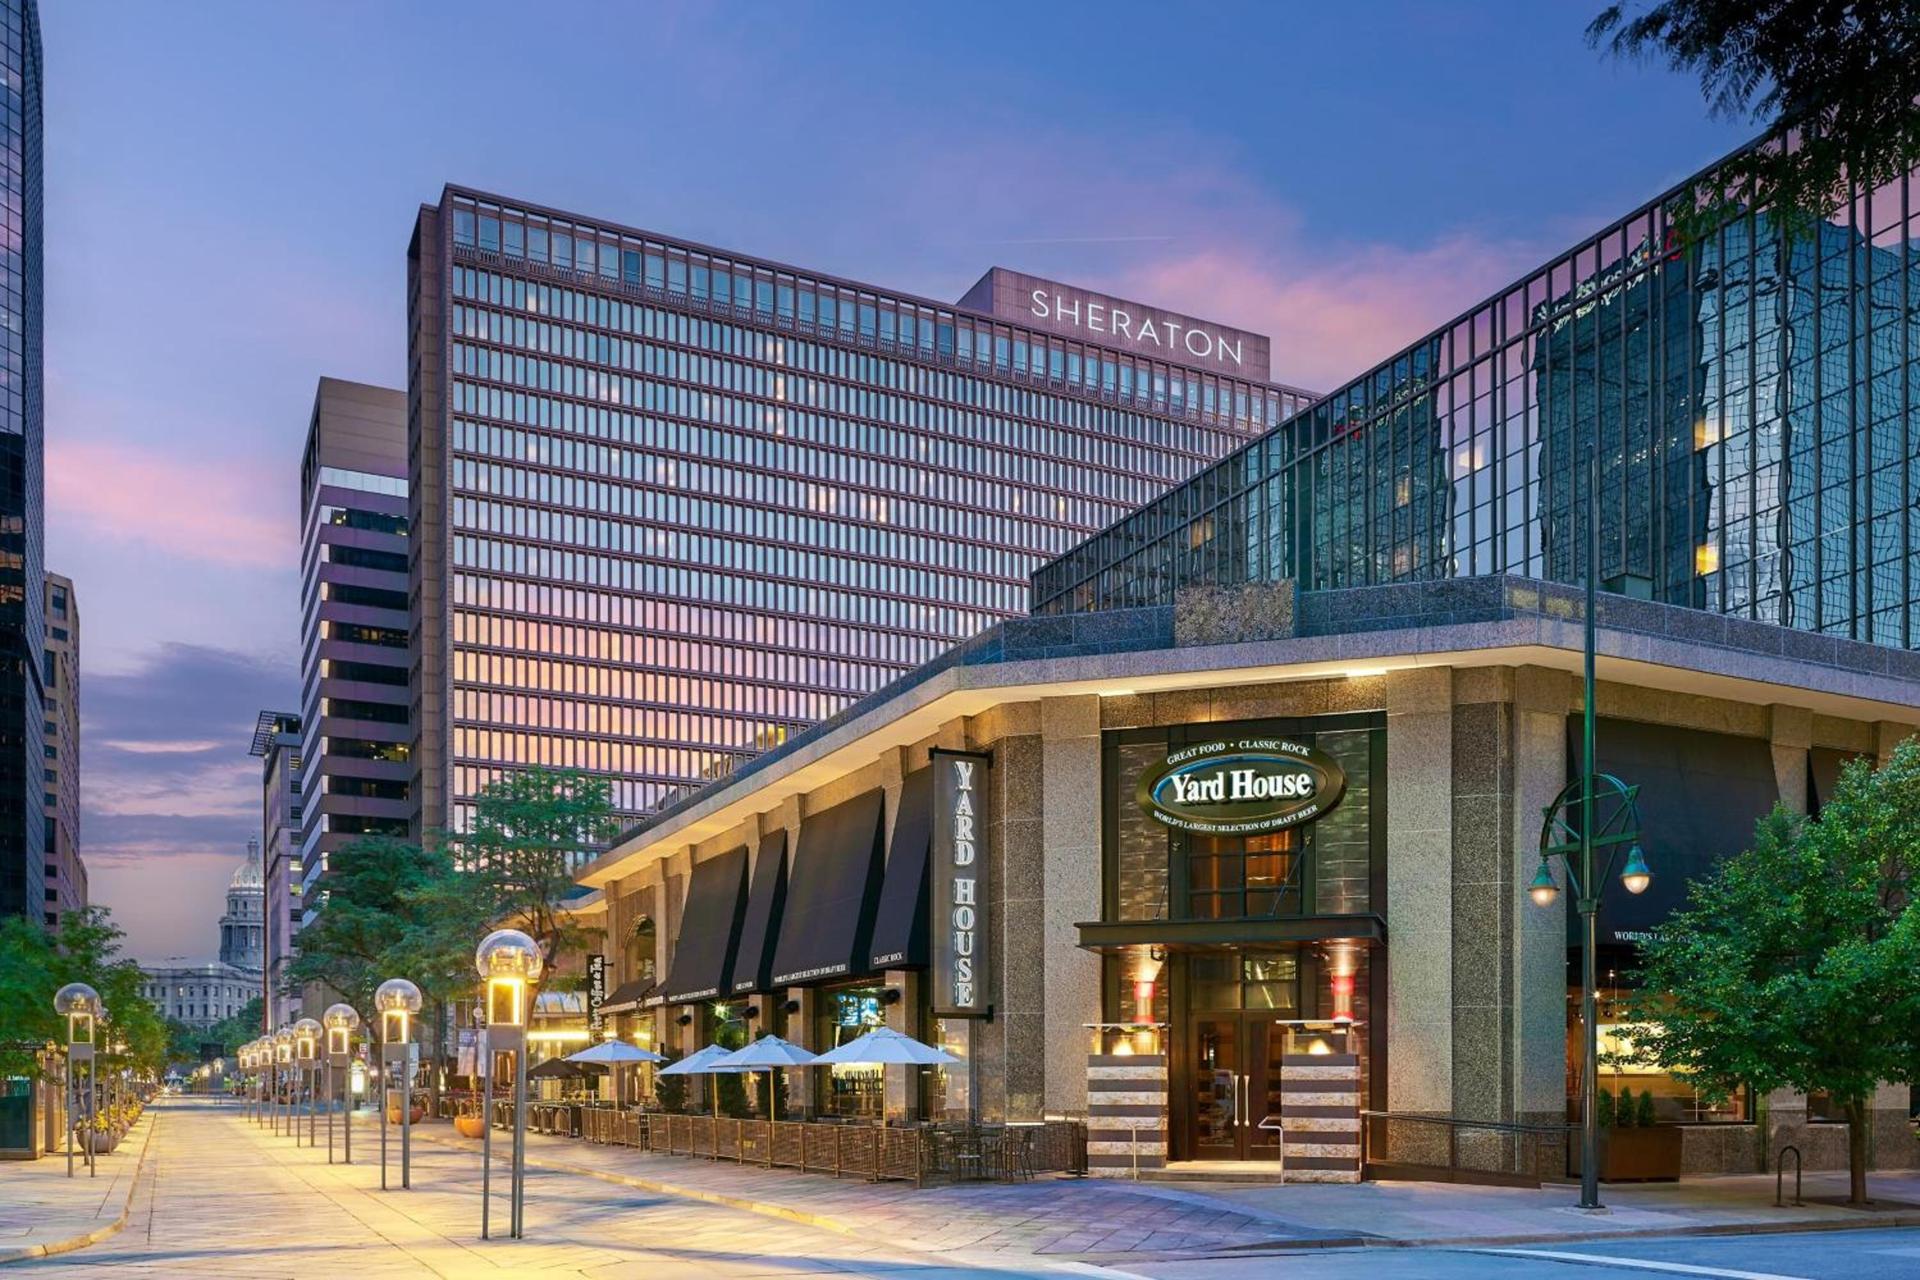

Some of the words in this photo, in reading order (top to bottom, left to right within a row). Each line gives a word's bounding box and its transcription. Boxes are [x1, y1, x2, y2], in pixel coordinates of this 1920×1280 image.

[1031, 290, 1242, 366] SHERATON
[1166, 748, 1198, 765] GREAT
[1199, 741, 1226, 754] FOOD
[1238, 740, 1280, 750] CLASSIC
[1281, 742, 1311, 757] ROCK
[1171, 771, 1225, 803] Yard
[1230, 769, 1312, 800] House
[954, 761, 975, 866] YARD
[1184, 821, 1217, 832] LARGEST
[1217, 822, 1260, 832] SELECTION
[1260, 820, 1272, 829] OF
[1271, 813, 1298, 827] DRAFT
[1298, 804, 1319, 819] BEER
[952, 878, 976, 1008] HOUSE
[589, 956, 603, 973] Tea
[590, 980, 604, 1008] Coffee
